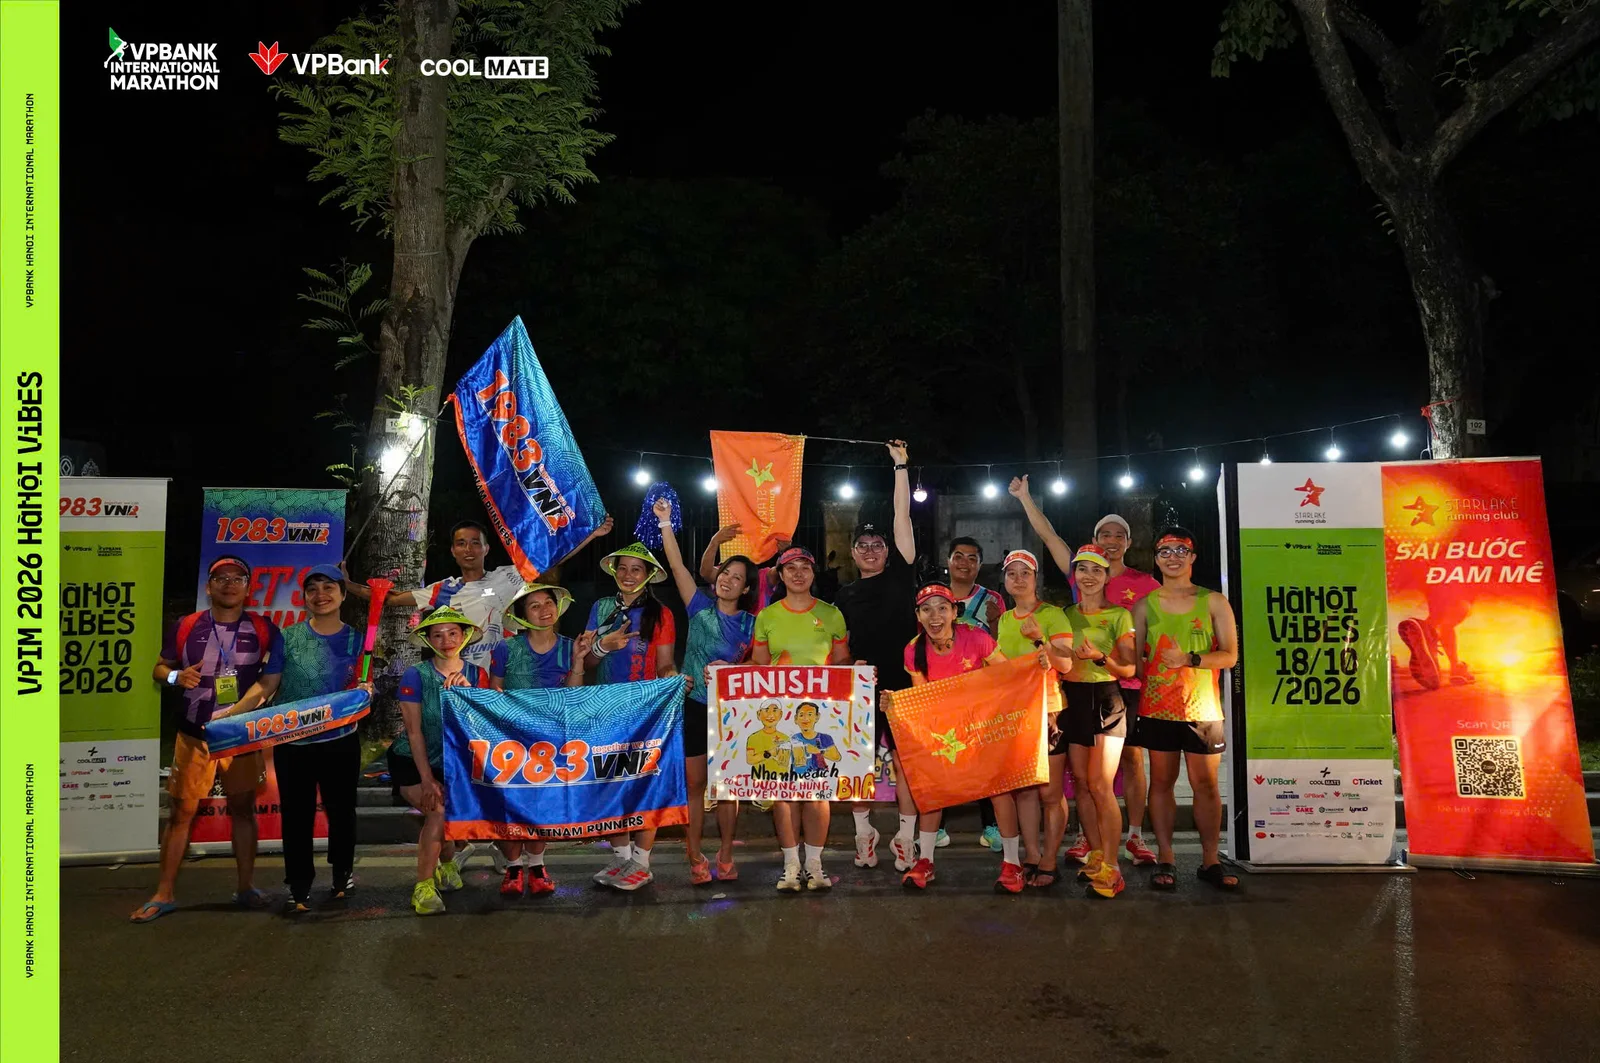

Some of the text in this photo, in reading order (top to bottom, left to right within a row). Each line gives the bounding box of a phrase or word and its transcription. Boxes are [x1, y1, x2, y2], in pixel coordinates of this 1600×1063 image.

[477, 369, 543, 472] 1983
[59, 497, 103, 516] 983
[1445, 497, 1518, 512] STARLAKE
[1447, 511, 1519, 522] running club
[216, 517, 287, 542] 1983
[1445, 537, 1527, 559] BƯỚC
[1426, 561, 1545, 584] ĐAM MÊ
[243, 566, 314, 607] ET'S
[59, 608, 136, 636] iBES
[1276, 647, 1358, 675] 18/10
[728, 669, 829, 696] FINISH
[1272, 677, 1361, 705] /2026
[245, 709, 299, 741] 1983
[1456, 720, 1488, 729] Scan
[468, 739, 590, 785] 1983
[836, 772, 875, 800] BIA
[526, 826, 582, 837] VIETNAM
[587, 815, 643, 832] RUNNERS
